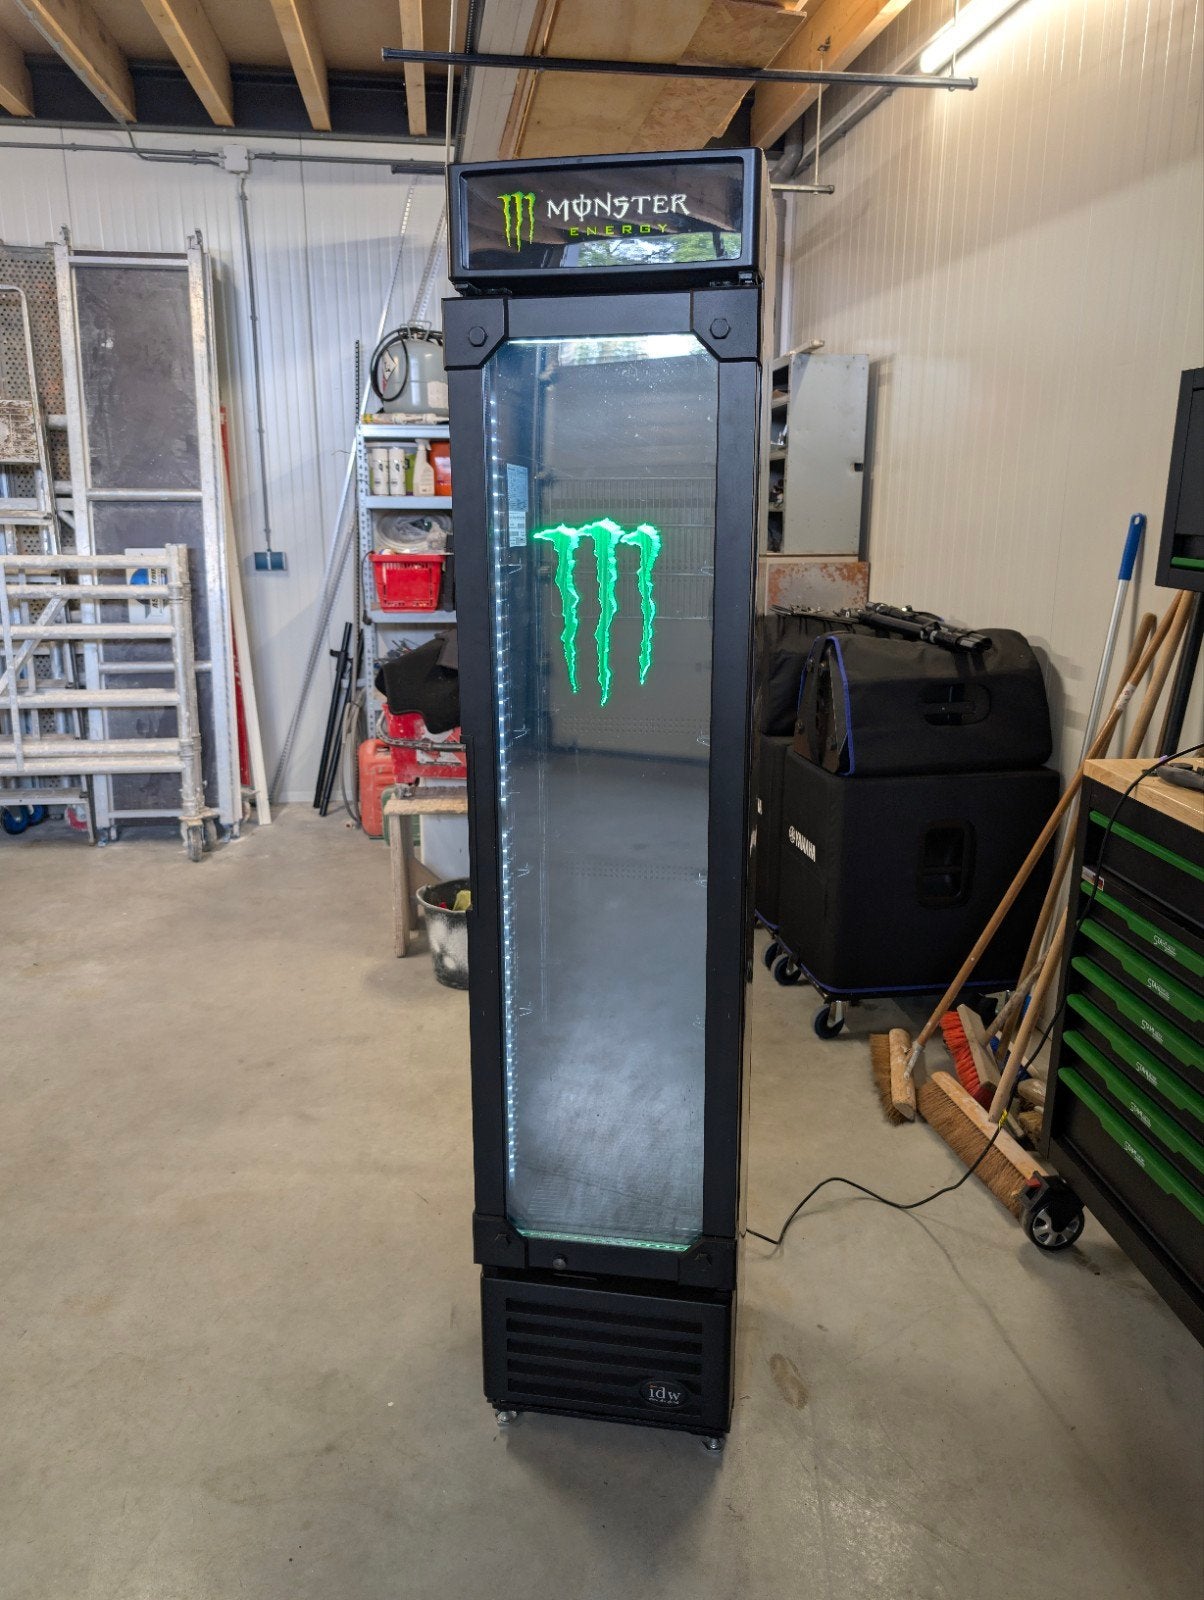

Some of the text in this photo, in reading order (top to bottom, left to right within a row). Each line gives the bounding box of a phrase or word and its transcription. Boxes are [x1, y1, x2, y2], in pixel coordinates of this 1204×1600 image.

[546, 192, 690, 222] MONSTER
[569, 223, 668, 237] ENERGY
[795, 830, 816, 862] YAMAHA
